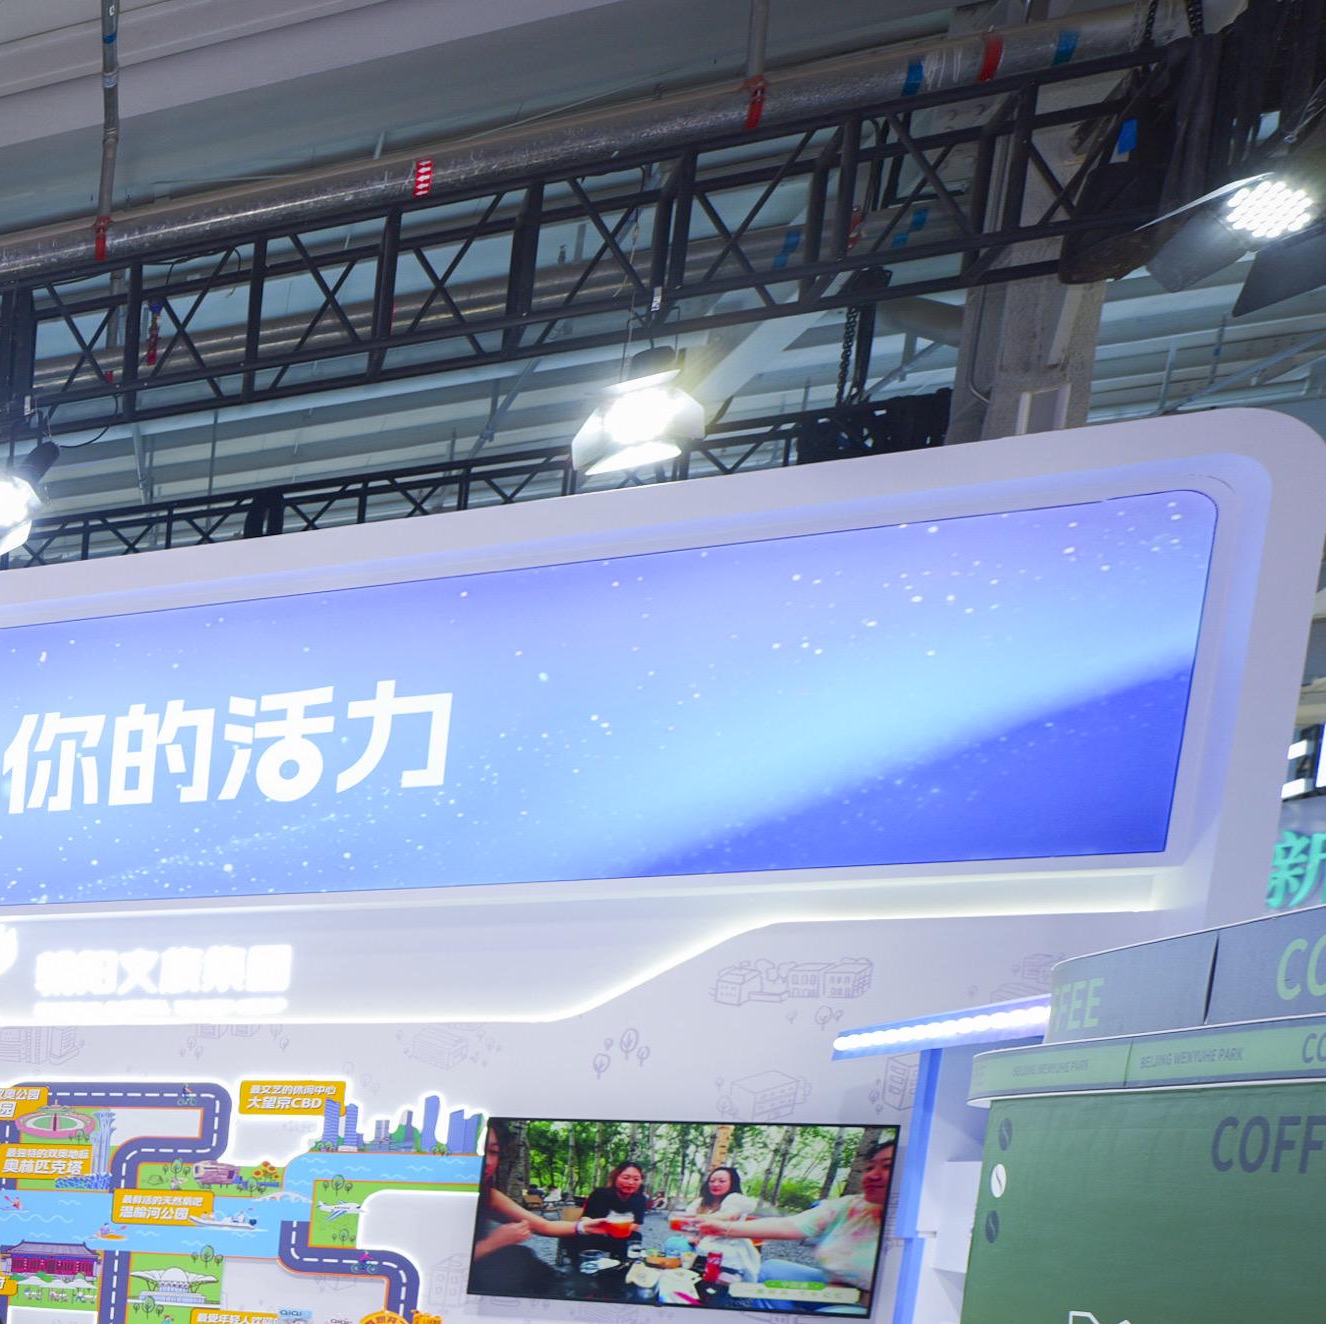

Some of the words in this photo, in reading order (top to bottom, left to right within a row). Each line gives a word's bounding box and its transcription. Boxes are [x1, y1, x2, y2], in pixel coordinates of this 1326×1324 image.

[3, 679, 454, 816] 你的活力
[1217, 1048, 1244, 1062] PARK
[247, 1098, 323, 1110] 大望京CBD
[1211, 1115, 1326, 1174] COFF
